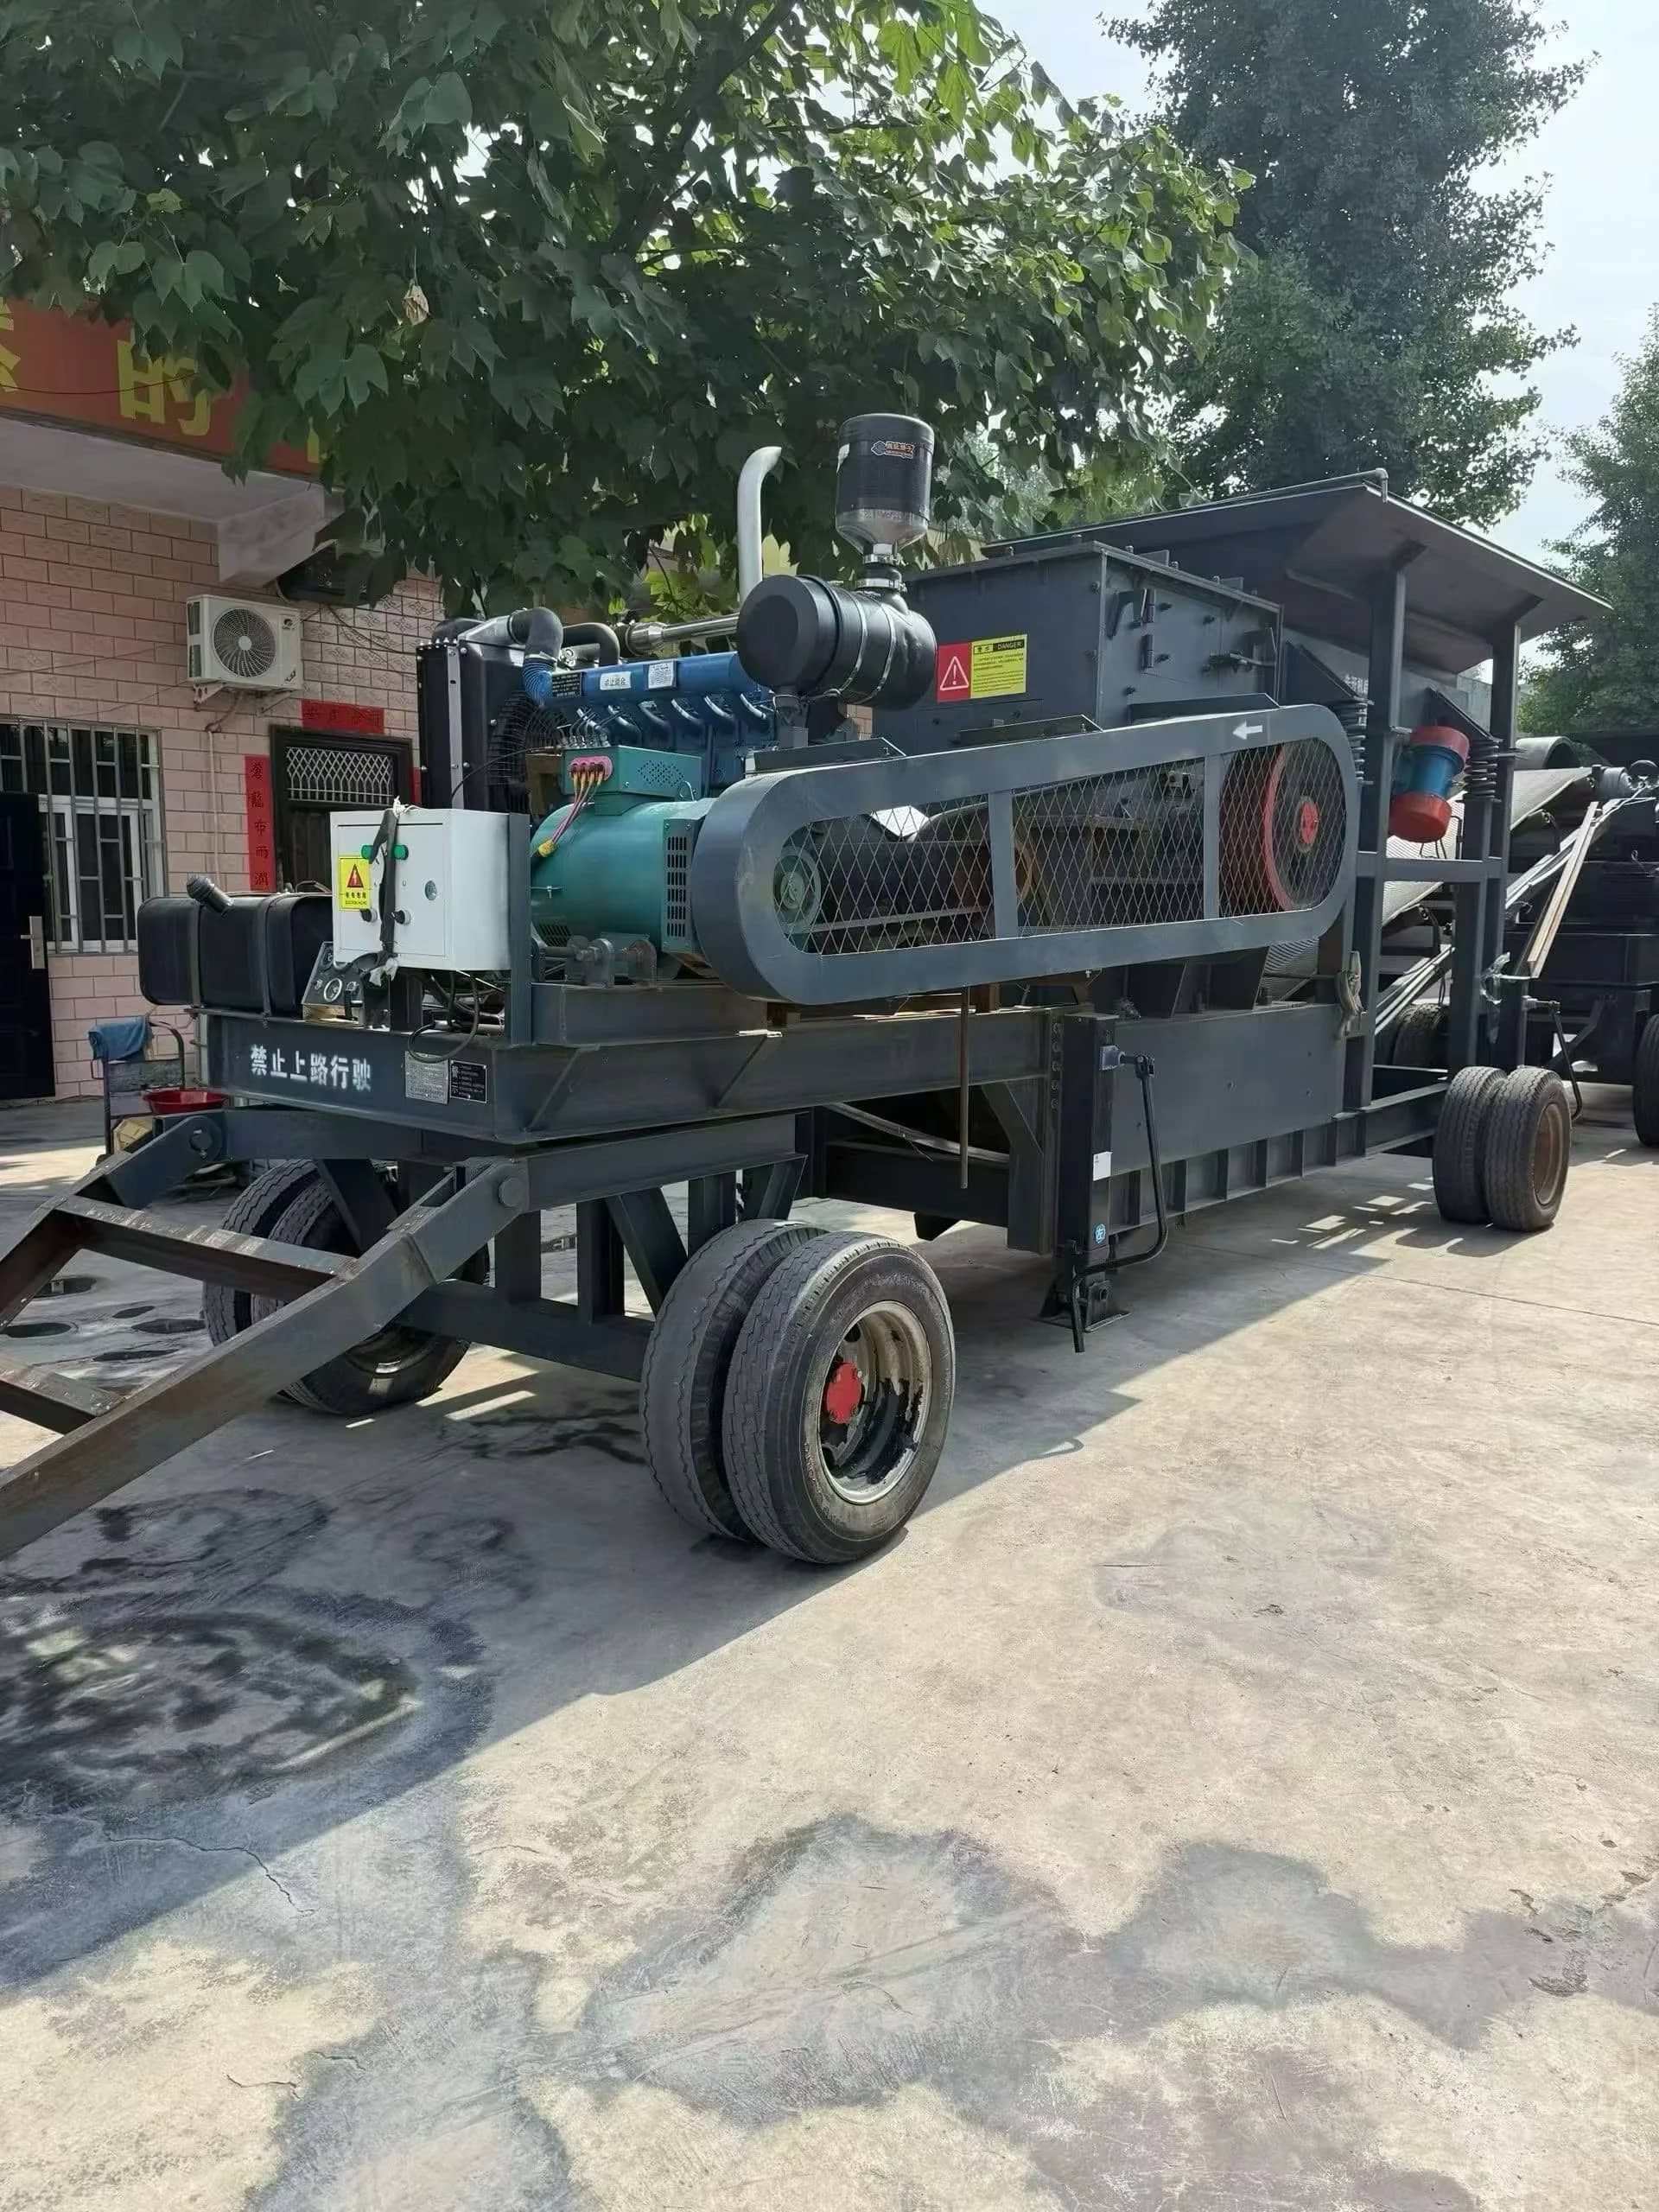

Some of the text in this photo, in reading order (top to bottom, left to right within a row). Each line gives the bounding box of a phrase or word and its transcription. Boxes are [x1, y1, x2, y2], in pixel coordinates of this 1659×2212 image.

[996, 641, 1022, 651] DANGER
[250, 1043, 372, 1091] 禁止上路行驶
